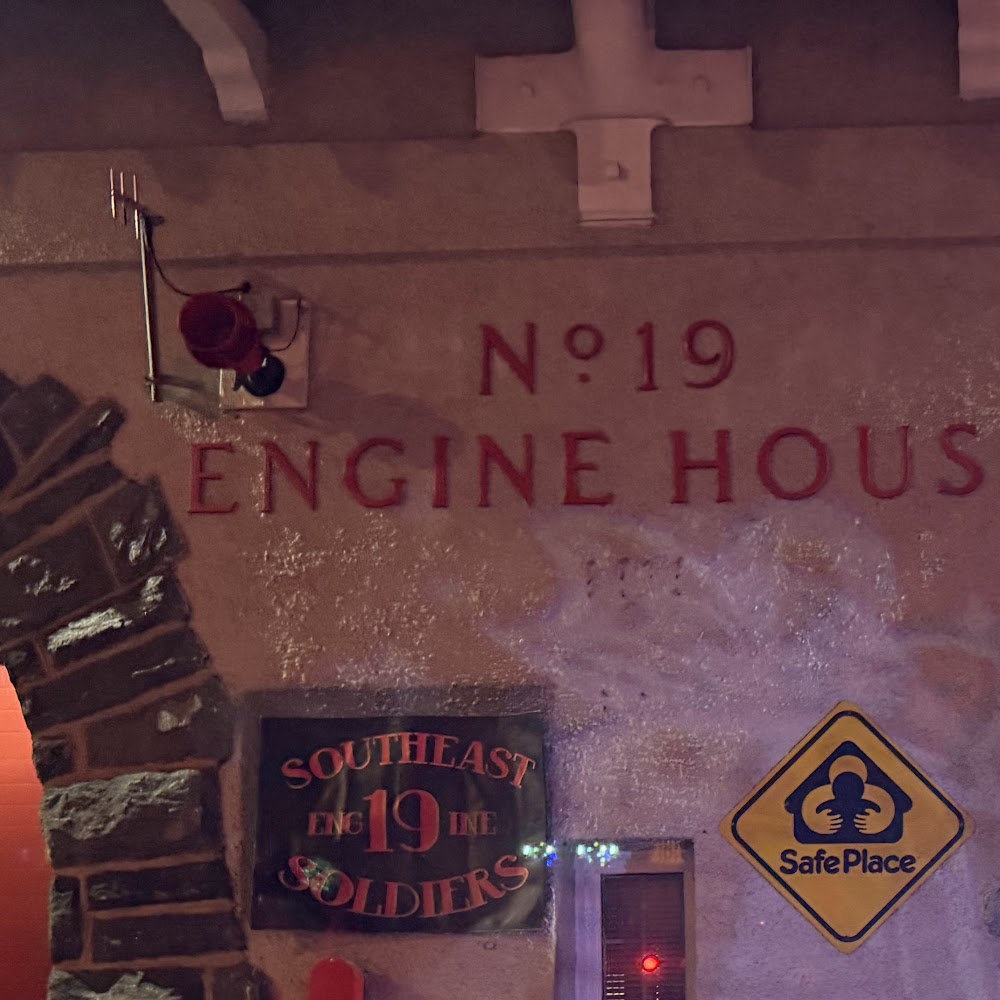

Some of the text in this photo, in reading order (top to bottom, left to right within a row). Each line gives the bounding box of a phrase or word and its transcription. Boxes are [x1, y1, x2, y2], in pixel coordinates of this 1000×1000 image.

[187, 430, 614, 515] ENGINE
[281, 732, 536, 790] SOUTHEAST
[307, 788, 497, 853] ENG 19 INE
[278, 854, 530, 918] SOLDIERS
[780, 848, 916, 875] Safe Place
